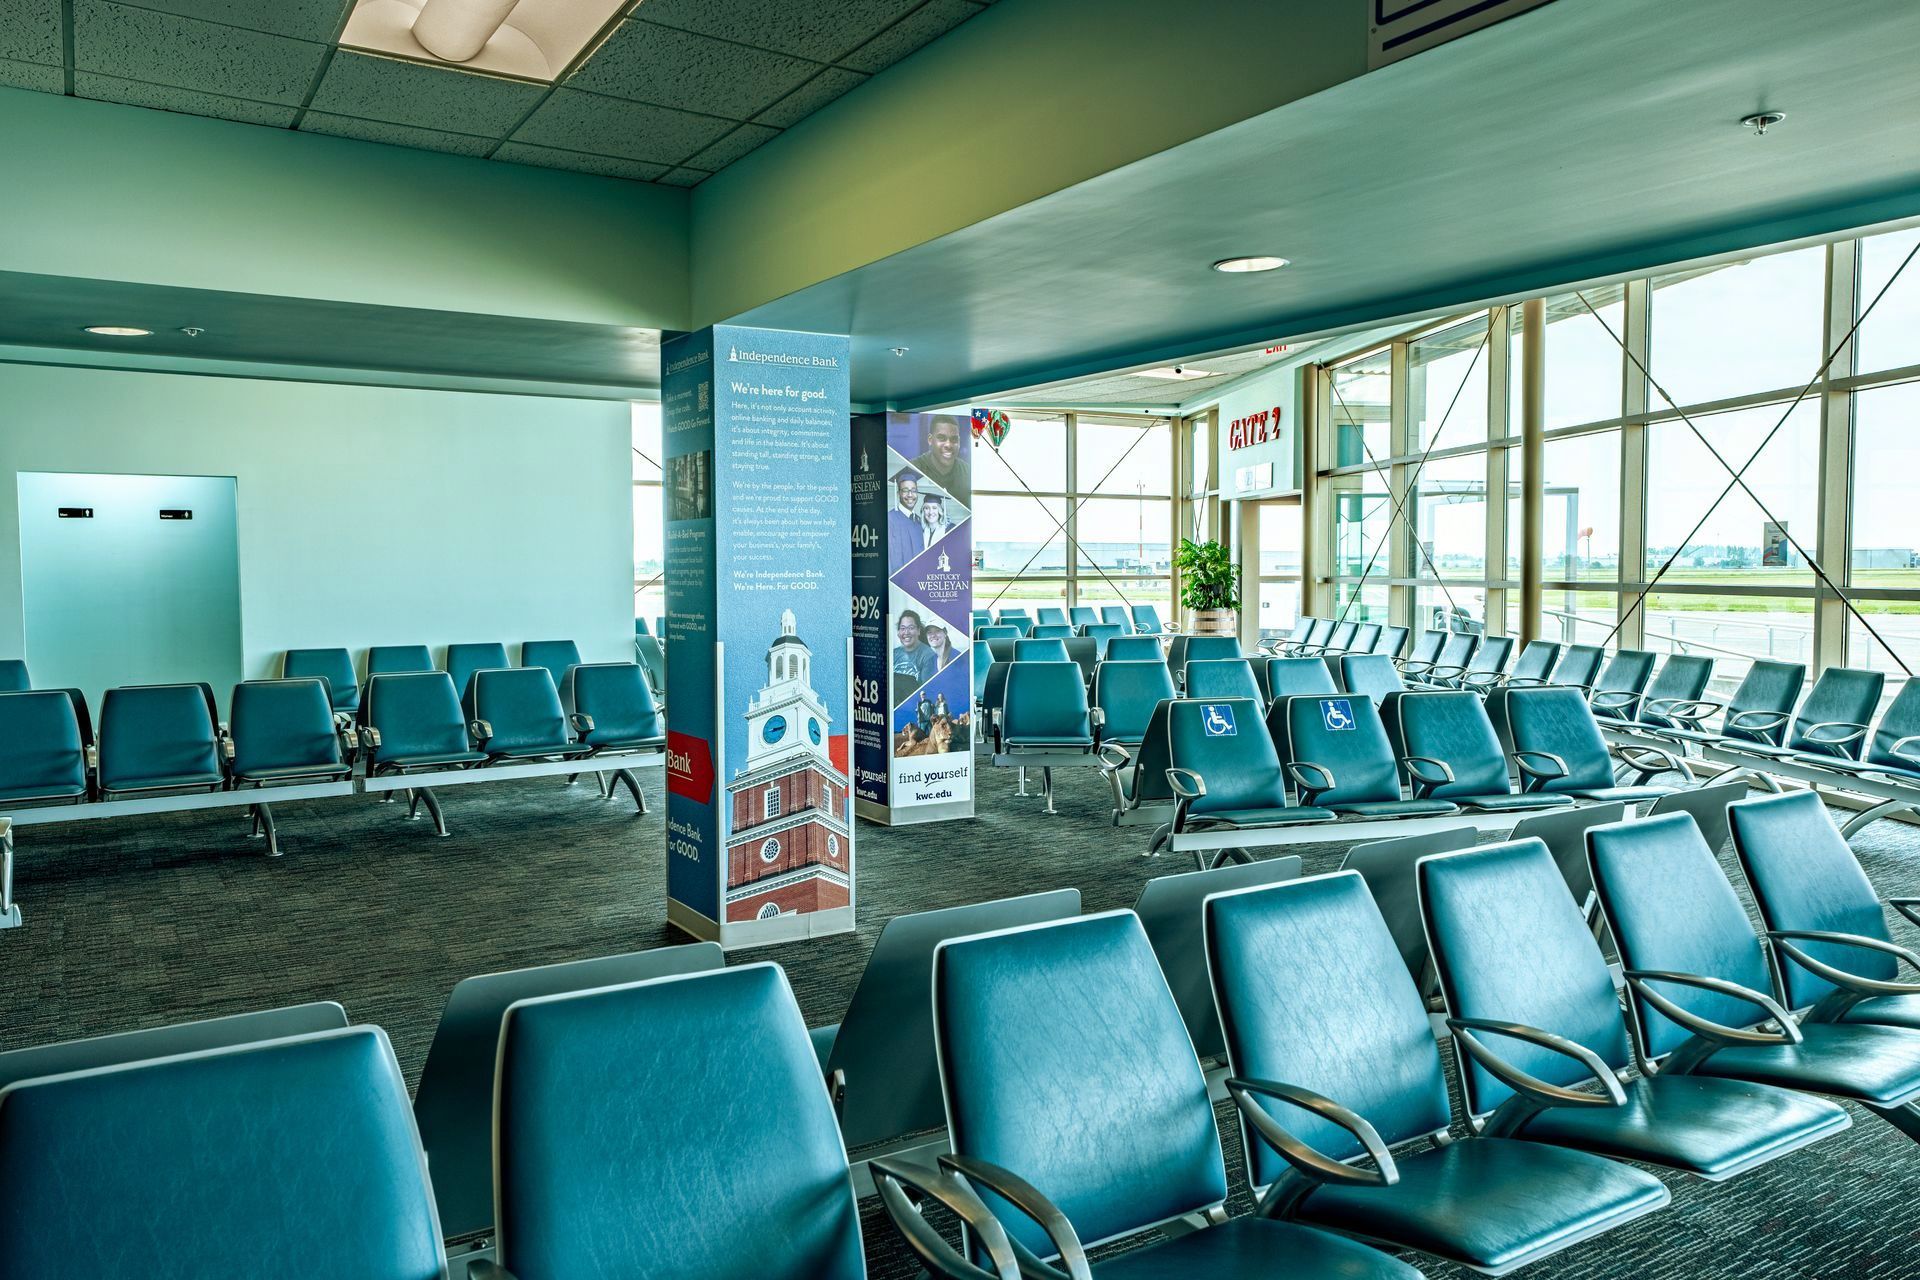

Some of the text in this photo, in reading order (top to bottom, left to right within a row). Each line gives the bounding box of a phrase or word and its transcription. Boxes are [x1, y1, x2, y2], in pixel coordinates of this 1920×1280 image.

[739, 350, 839, 368] Independence Bank
[731, 381, 827, 402] We're here for good.
[731, 401, 750, 411] Here,
[751, 402, 760, 410] it's
[773, 404, 787, 414] only
[813, 407, 838, 417] activity,
[731, 413, 751, 421] online
[752, 415, 776, 425] banking
[777, 416, 789, 424] and
[790, 416, 804, 426] daily
[731, 425, 741, 433] it's
[742, 426, 760, 434] about
[761, 428, 790, 437] integrity,
[1229, 406, 1281, 451] GATE 2
[744, 438, 755, 446] life
[811, 441, 829, 449] about
[732, 450, 758, 460] standing
[772, 452, 798, 462] standing
[799, 453, 820, 462] strong,
[821, 453, 833, 461] and
[732, 463, 755, 472] staying
[732, 480, 752, 489] We're
[752, 481, 760, 491] by
[761, 481, 772, 489] the
[796, 482, 806, 490] for
[807, 483, 818, 491] the
[818, 484, 838, 494] people
[732, 493, 745, 501] and
[763, 494, 782, 503] proud
[790, 496, 814, 505] support
[814, 495, 839, 503] GOOD
[756, 505, 764, 513] At
[790, 505, 798, 514] of
[799, 506, 809, 514] the
[743, 518, 764, 529] always
[823, 518, 837, 528] help
[756, 531, 788, 539] encourage
[801, 531, 831, 540] empower
[851, 524, 879, 548] 40+
[732, 543, 747, 551] your
[781, 543, 796, 551] your
[733, 569, 826, 581] We're Independence Bank.
[926, 573, 961, 581] KENTUCKY
[733, 581, 820, 591] We're Here. For GOOD.
[917, 580, 969, 591] WESLEYAN
[928, 590, 958, 598] COLLEGE
[852, 595, 880, 620] 99%
[854, 675, 879, 704] $18
[668, 749, 692, 774] Bank
[861, 769, 887, 783] yourself
[899, 767, 968, 784] find yourself
[856, 786, 878, 799] kwc.edu
[915, 790, 952, 800] kwc.edu
[668, 817, 703, 843] dence Bank.
[676, 839, 700, 863] GOOD.
